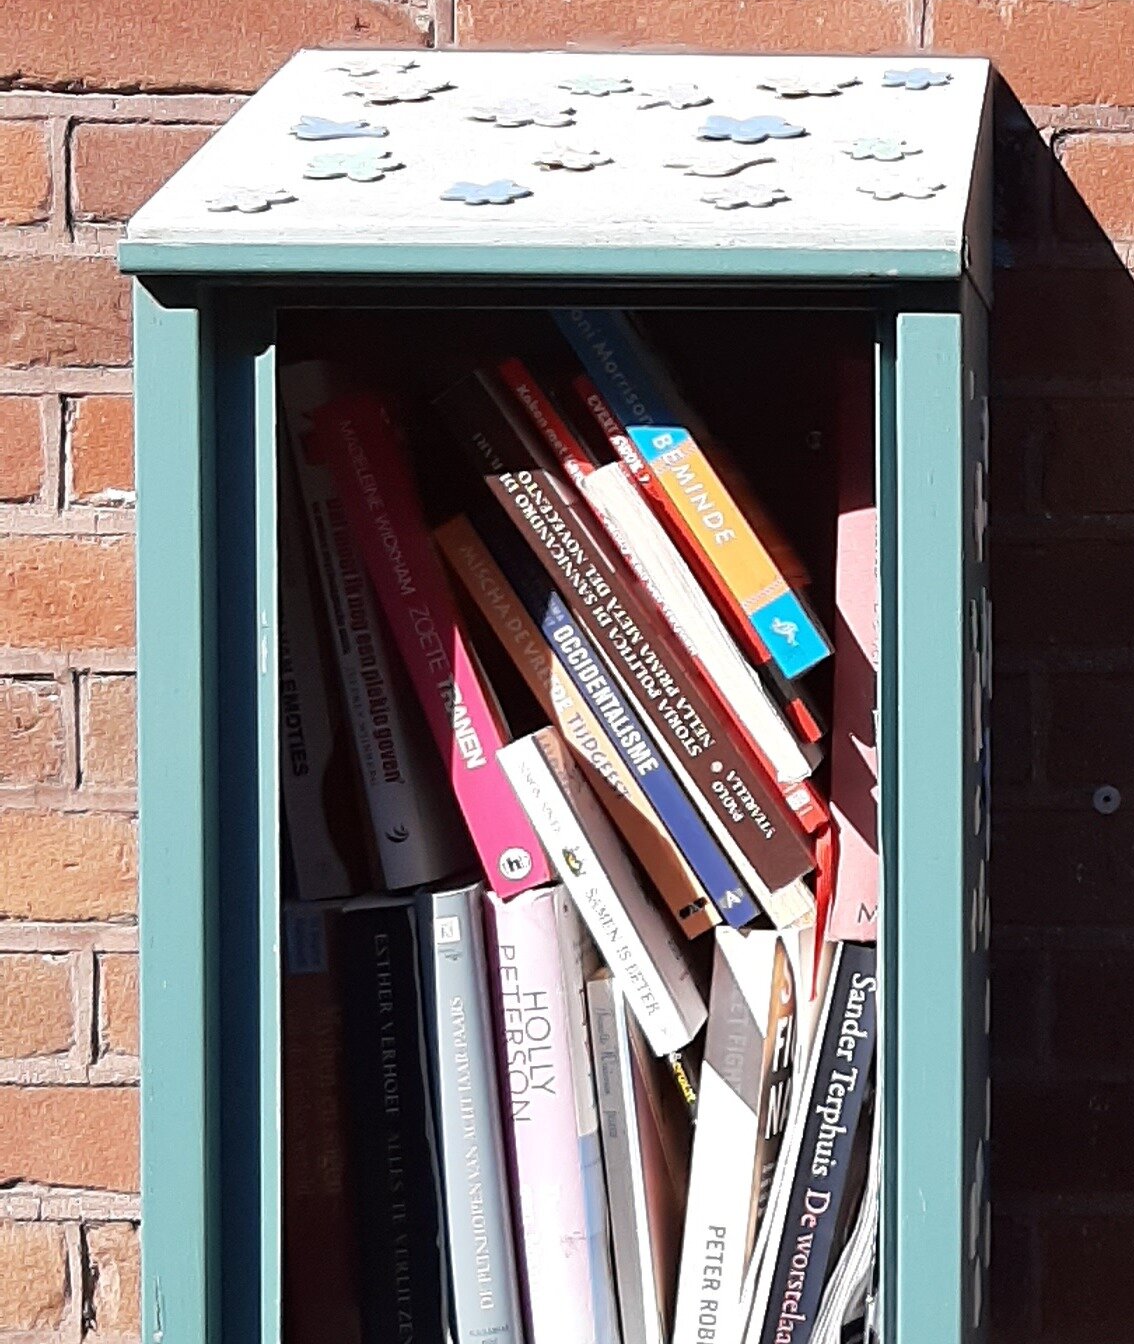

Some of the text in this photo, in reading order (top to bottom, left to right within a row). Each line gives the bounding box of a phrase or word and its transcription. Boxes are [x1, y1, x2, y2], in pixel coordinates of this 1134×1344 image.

[593, 341, 655, 426] Morrison
[499, 472, 520, 493] DI
[517, 469, 588, 565] NOVECENTO
[652, 432, 736, 545] BEMINDE
[515, 493, 598, 607] SANNICANDRO
[585, 563, 613, 599] DEL
[592, 605, 613, 628] DI
[408, 604, 448, 674] ZOETE
[436, 675, 488, 771] TRANEN
[552, 623, 660, 777] OCCIDENTALISME
[607, 629, 662, 700] POLITICA
[639, 644, 681, 698] PRIMA
[566, 711, 631, 799] TIJDGEEST
[657, 698, 703, 758] STORIA
[676, 696, 717, 749] NELLA
[711, 780, 745, 824] PAOLO
[726, 769, 776, 840] VITARELLA
[584, 886, 624, 943] SAMEN
[614, 943, 633, 963] IS
[374, 932, 394, 1016] ESTHER
[450, 995, 469, 1048] PAARS
[500, 944, 532, 1122] PETERSON
[522, 990, 557, 1095] HOLLY
[836, 971, 877, 1063] Sander
[811, 1066, 859, 1179] Terphuis
[464, 1145, 481, 1179] VAN
[800, 1187, 832, 1230] De
[703, 1224, 727, 1291] PETER
[478, 1290, 495, 1311] DE
